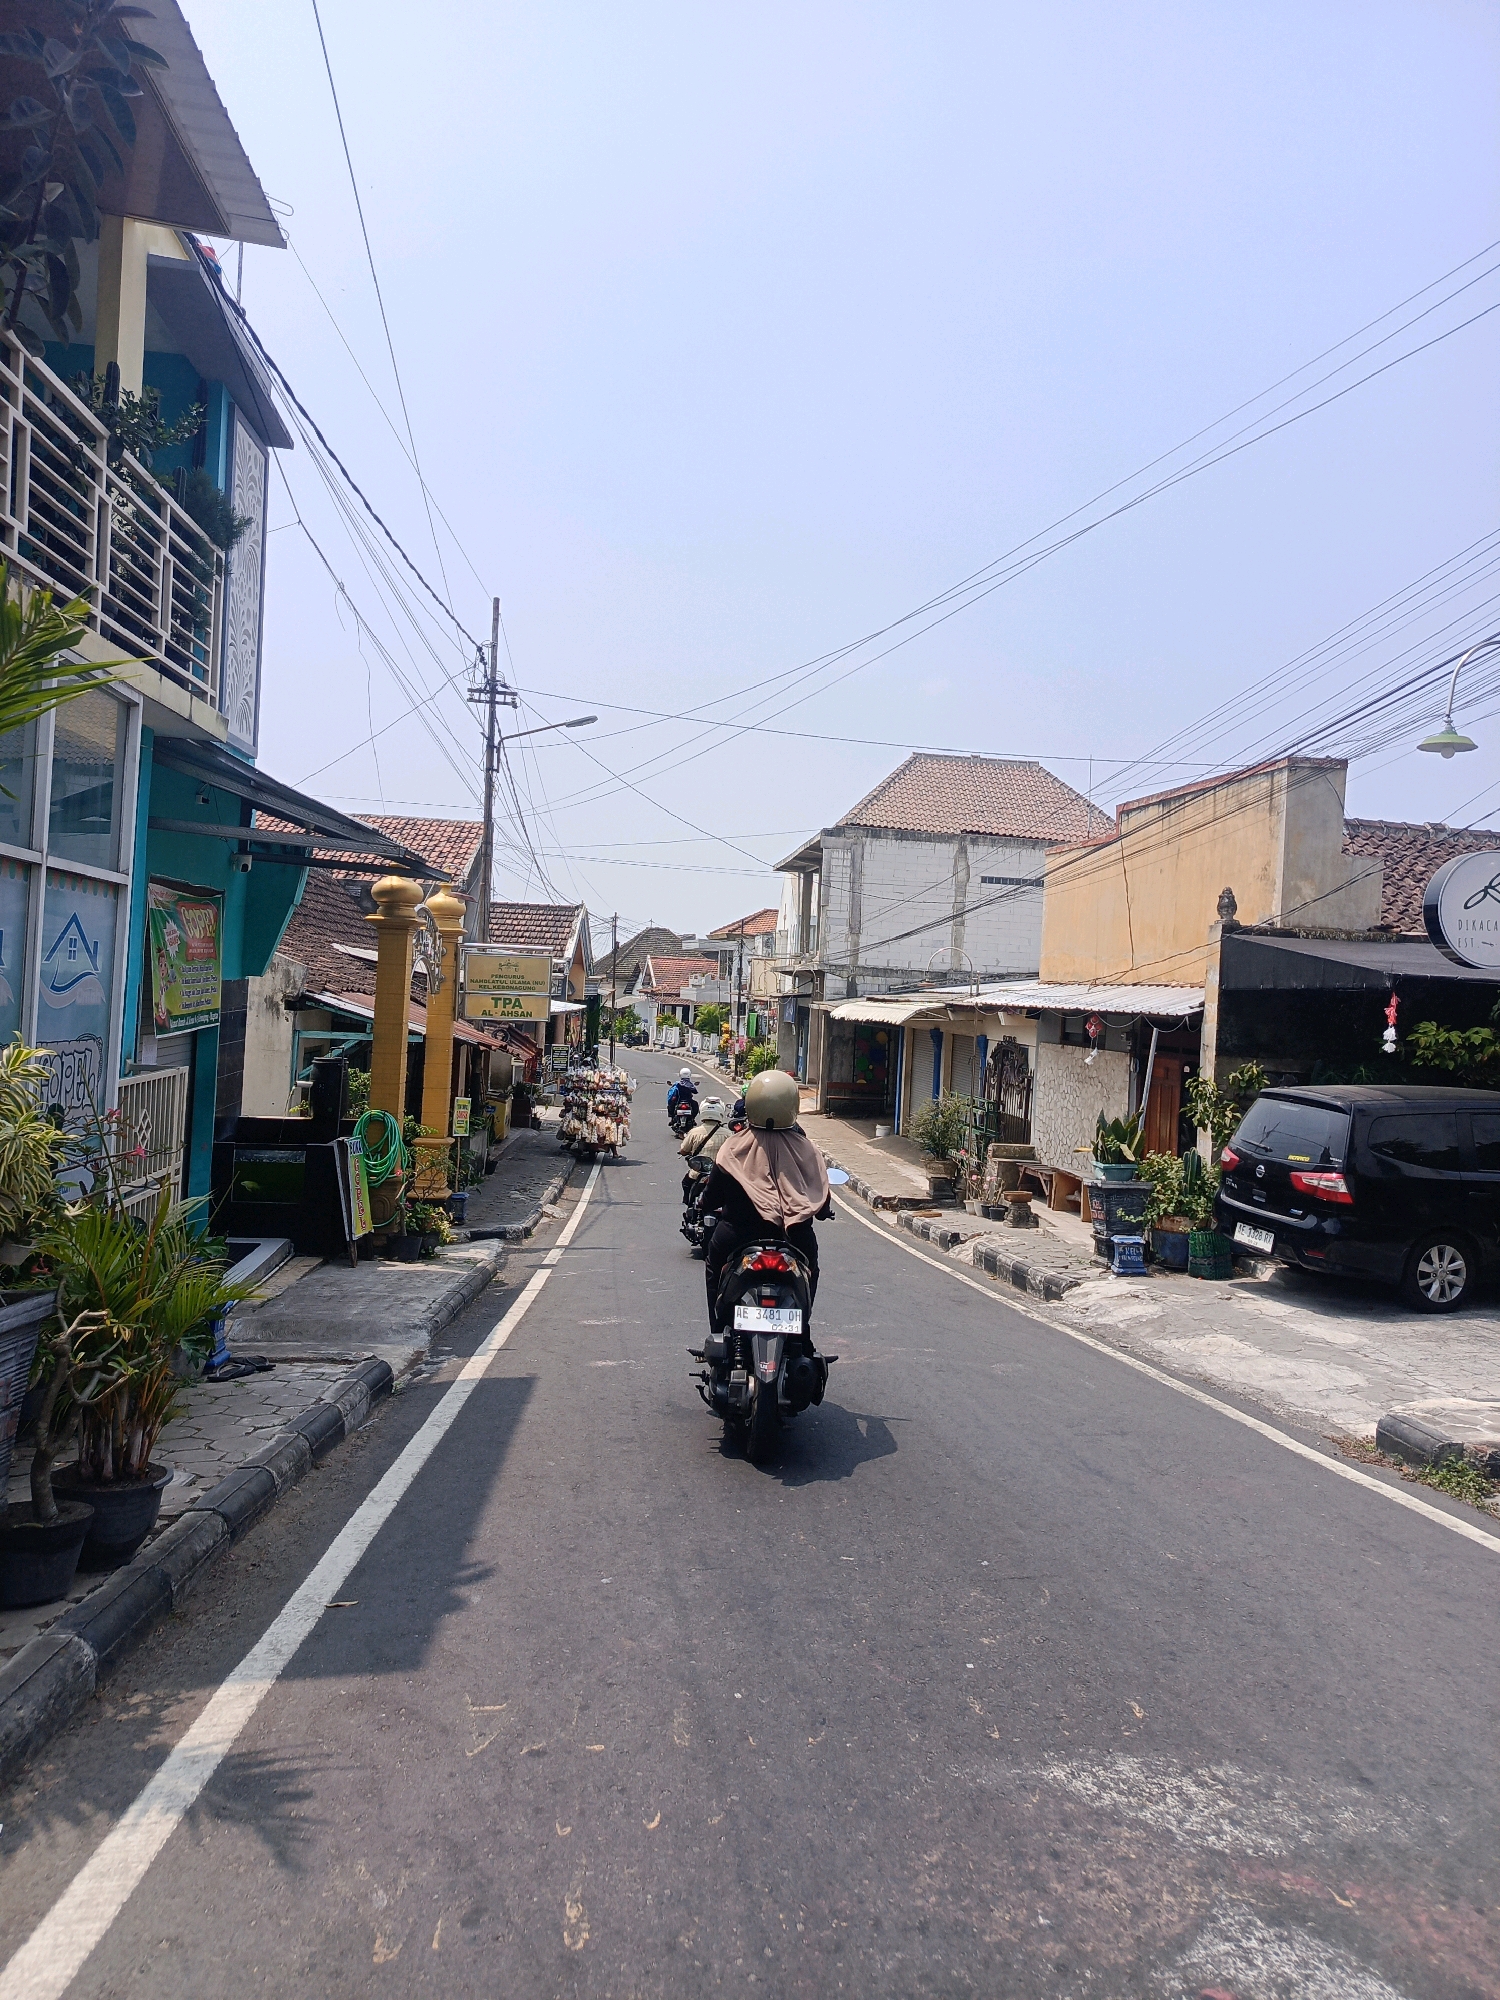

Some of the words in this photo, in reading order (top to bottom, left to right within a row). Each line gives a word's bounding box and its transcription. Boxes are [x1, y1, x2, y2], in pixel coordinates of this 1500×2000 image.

[491, 997, 523, 1009] TPA
[736, 1307, 749, 1319] AE
[755, 1308, 782, 1321] 3481
